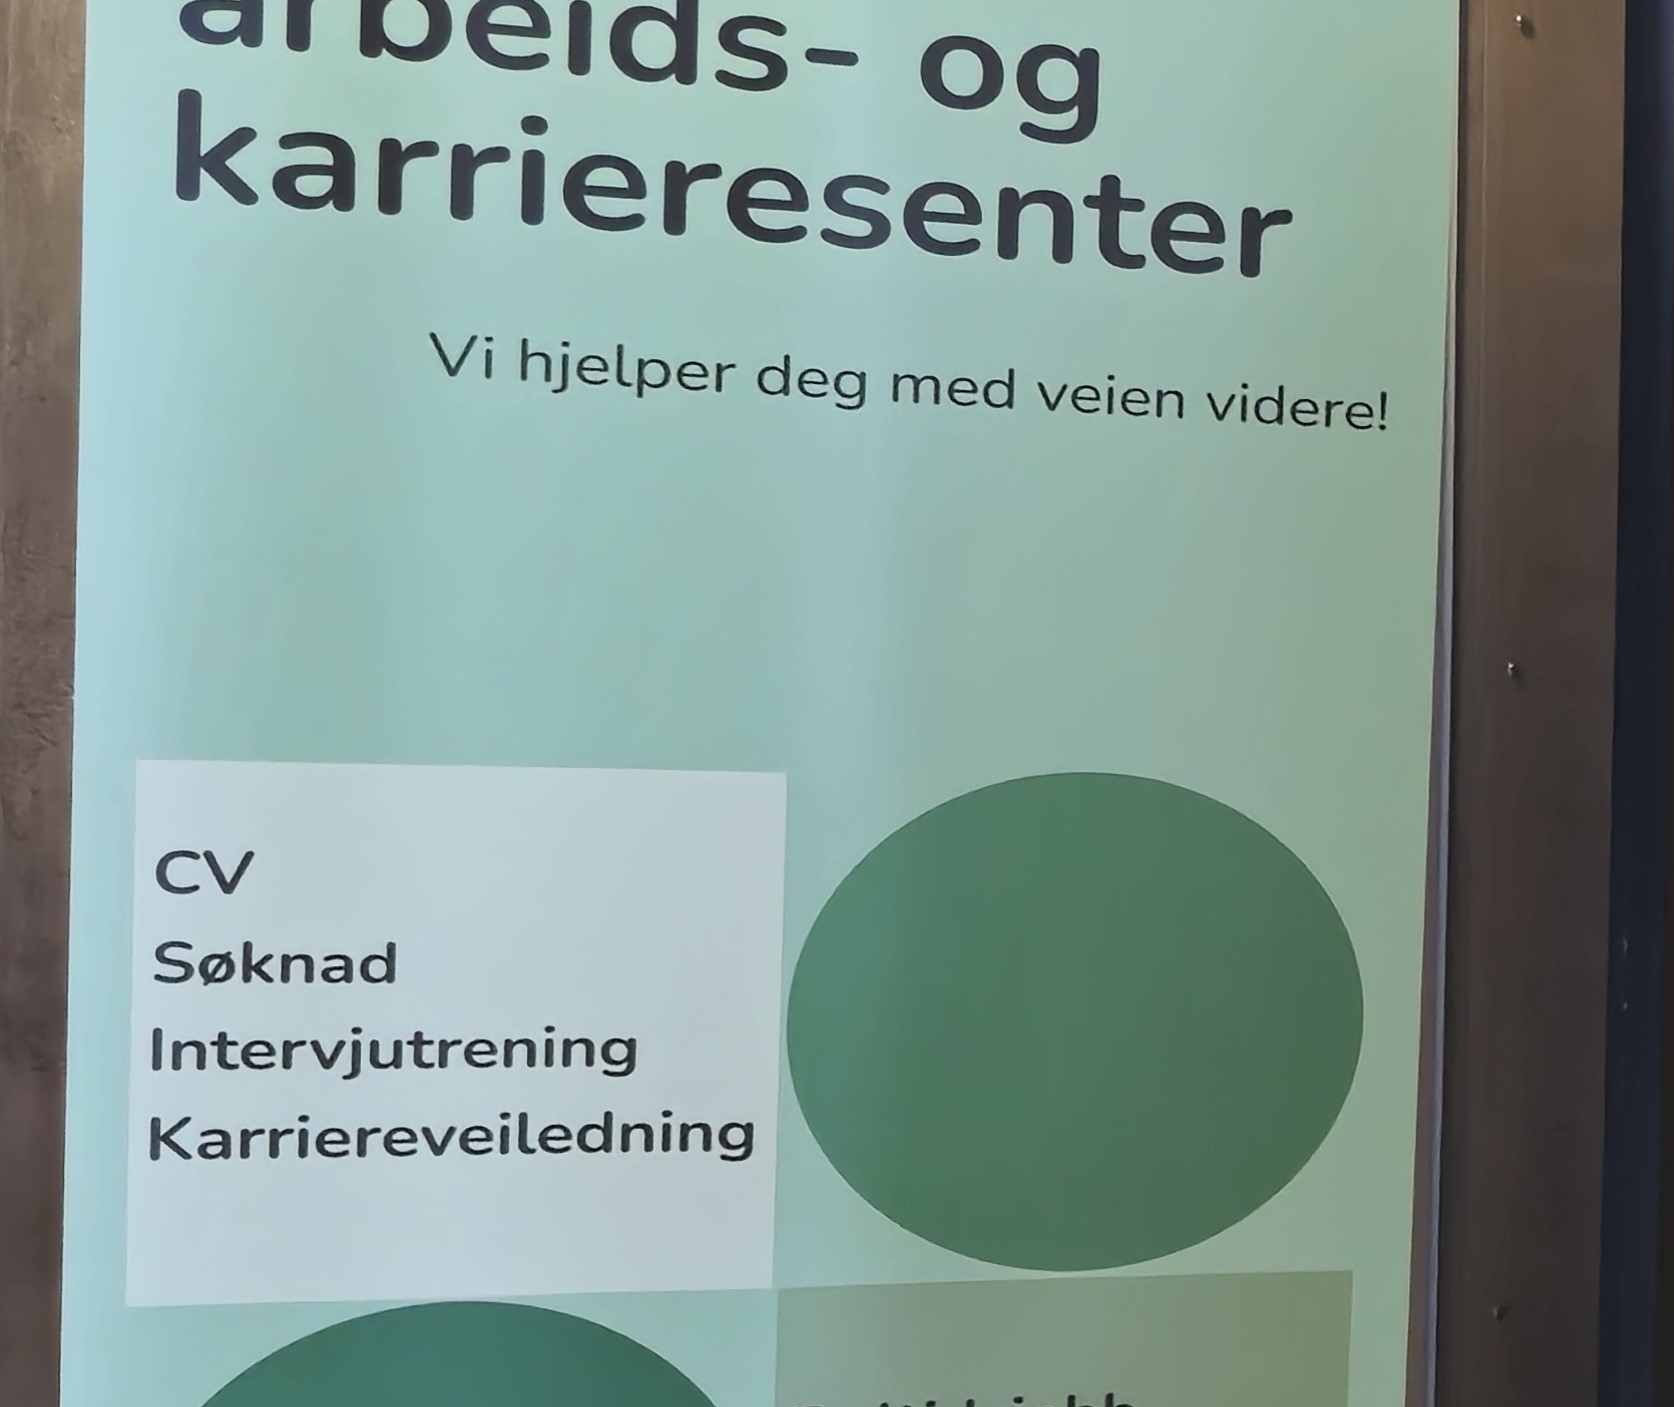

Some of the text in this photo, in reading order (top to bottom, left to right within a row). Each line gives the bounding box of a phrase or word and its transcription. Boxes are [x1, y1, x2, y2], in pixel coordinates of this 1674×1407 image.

[920, 35, 1100, 145] og
[175, 85, 1294, 279] karrieresenter
[429, 331, 1388, 431] Vi hjelper deg med veien videre!
[155, 849, 255, 895] CV
[153, 940, 397, 987] Søknad
[151, 1025, 637, 1081] Intervjutrening
[149, 1109, 755, 1163] Karriereveiledning
